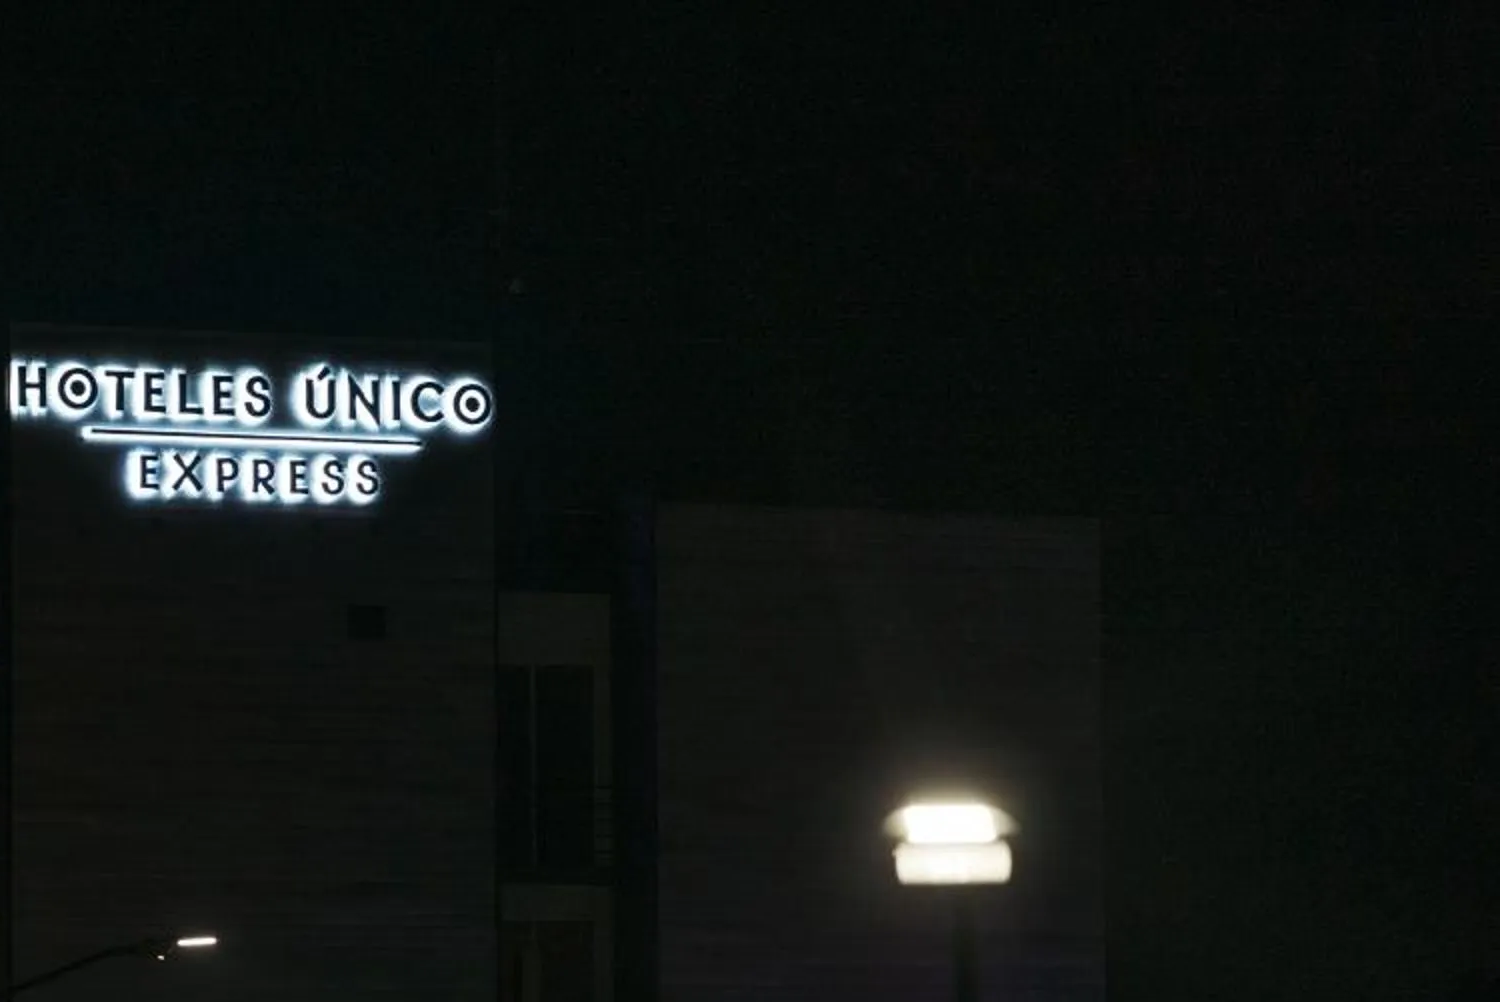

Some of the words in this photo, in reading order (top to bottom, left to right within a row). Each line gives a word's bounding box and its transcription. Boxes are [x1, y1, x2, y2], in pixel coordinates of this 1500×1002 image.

[15, 364, 273, 418] HOTELES
[304, 365, 493, 427] ÚNICO
[138, 452, 381, 497] EXPRESS
